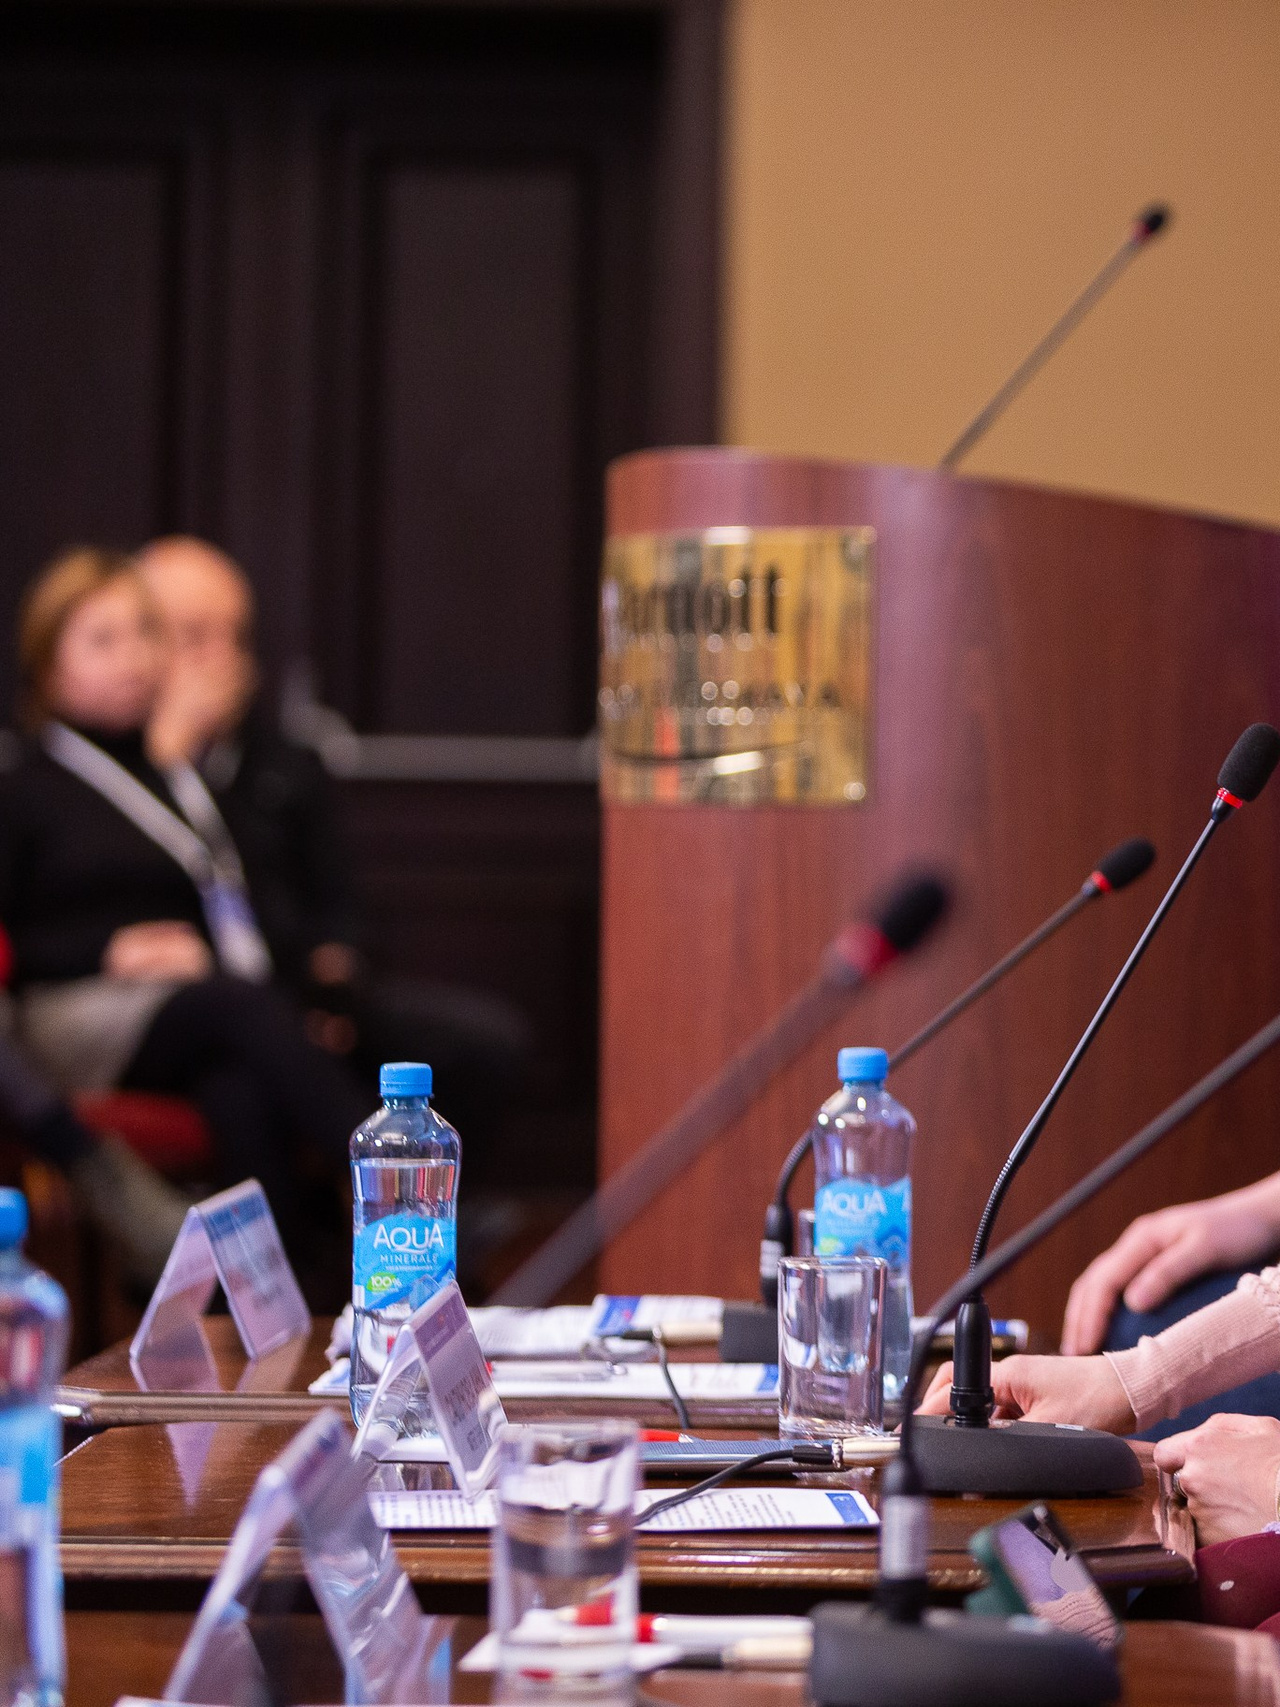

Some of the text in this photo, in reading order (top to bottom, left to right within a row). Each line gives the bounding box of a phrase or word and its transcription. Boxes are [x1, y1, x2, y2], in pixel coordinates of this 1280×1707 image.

[821, 1189, 888, 1220] AQUA
[373, 1223, 444, 1254] AQUA
[380, 1253, 438, 1264] MINERALE
[371, 1276, 402, 1288] 100%
